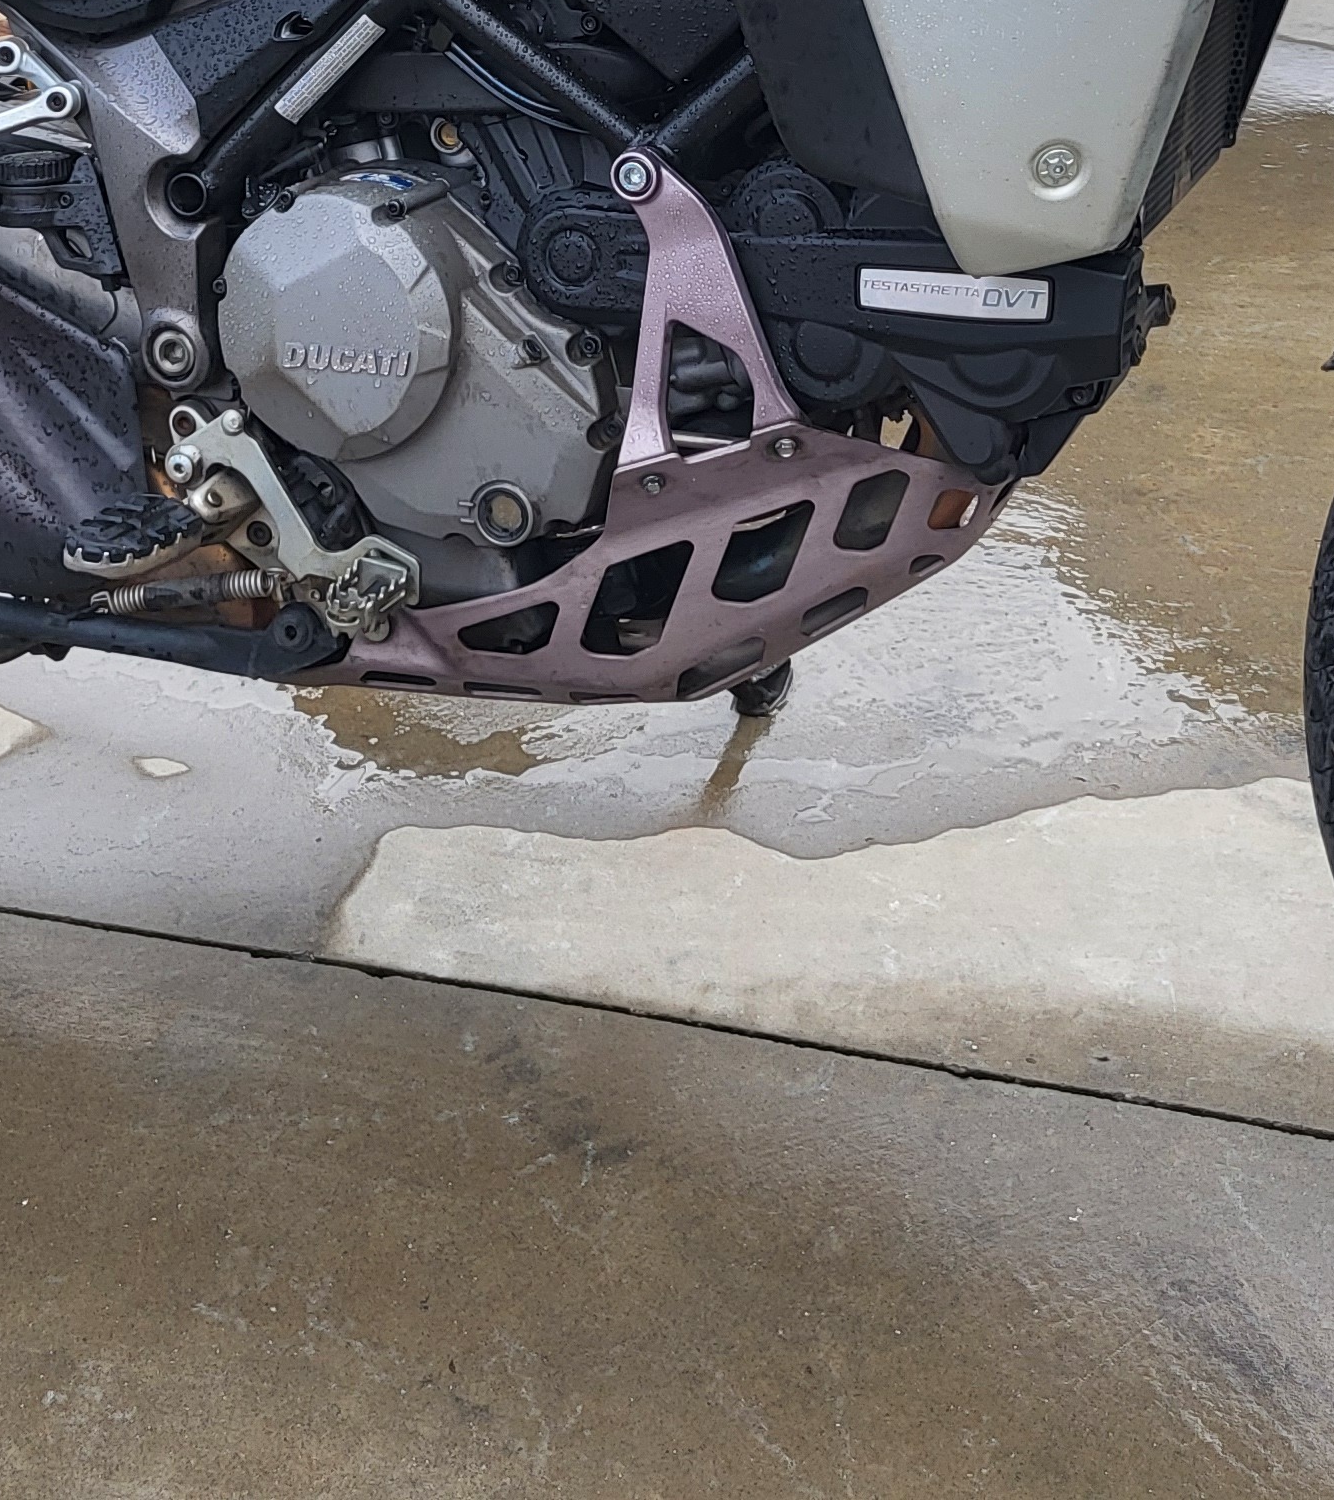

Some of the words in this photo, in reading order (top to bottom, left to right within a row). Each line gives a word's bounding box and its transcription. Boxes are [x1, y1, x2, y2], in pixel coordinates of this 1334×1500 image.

[863, 278, 980, 298] TESTASTRETTA
[981, 287, 1047, 310] DVT
[281, 341, 412, 377] DUCATI
